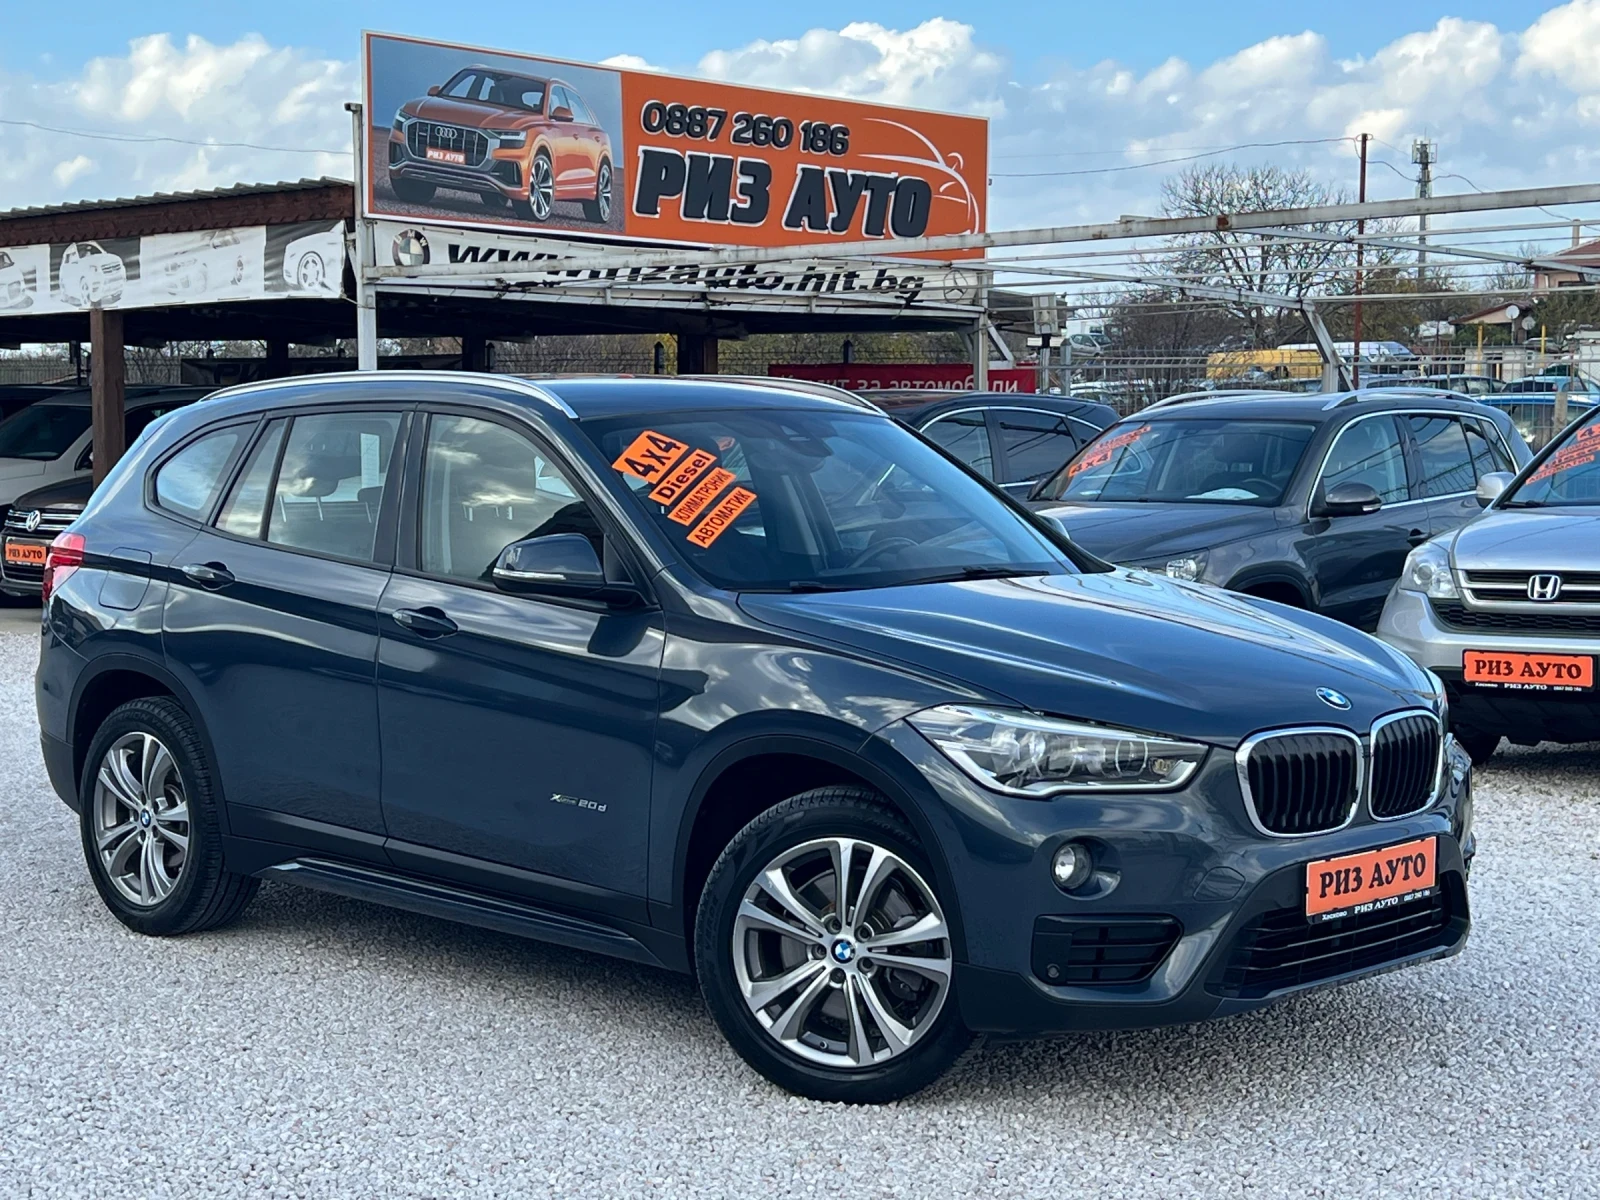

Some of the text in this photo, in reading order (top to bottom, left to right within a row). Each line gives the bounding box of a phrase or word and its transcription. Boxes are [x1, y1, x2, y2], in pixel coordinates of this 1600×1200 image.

[641, 100, 850, 156] 0887 260 186
[633, 146, 932, 238] РИЗ АУТО
[889, 375, 1018, 393] автомобли
[655, 453, 711, 500] Diesel
[674, 469, 732, 522] КЛИМАТРОНИК
[694, 490, 751, 544] АВТОМАТИК
[1475, 659, 1582, 679] РИЗ АУТО
[1319, 852, 1426, 898] РИЗ АУТО
[1354, 903, 1373, 915] РИЗ
[1374, 896, 1399, 910] АУТО
